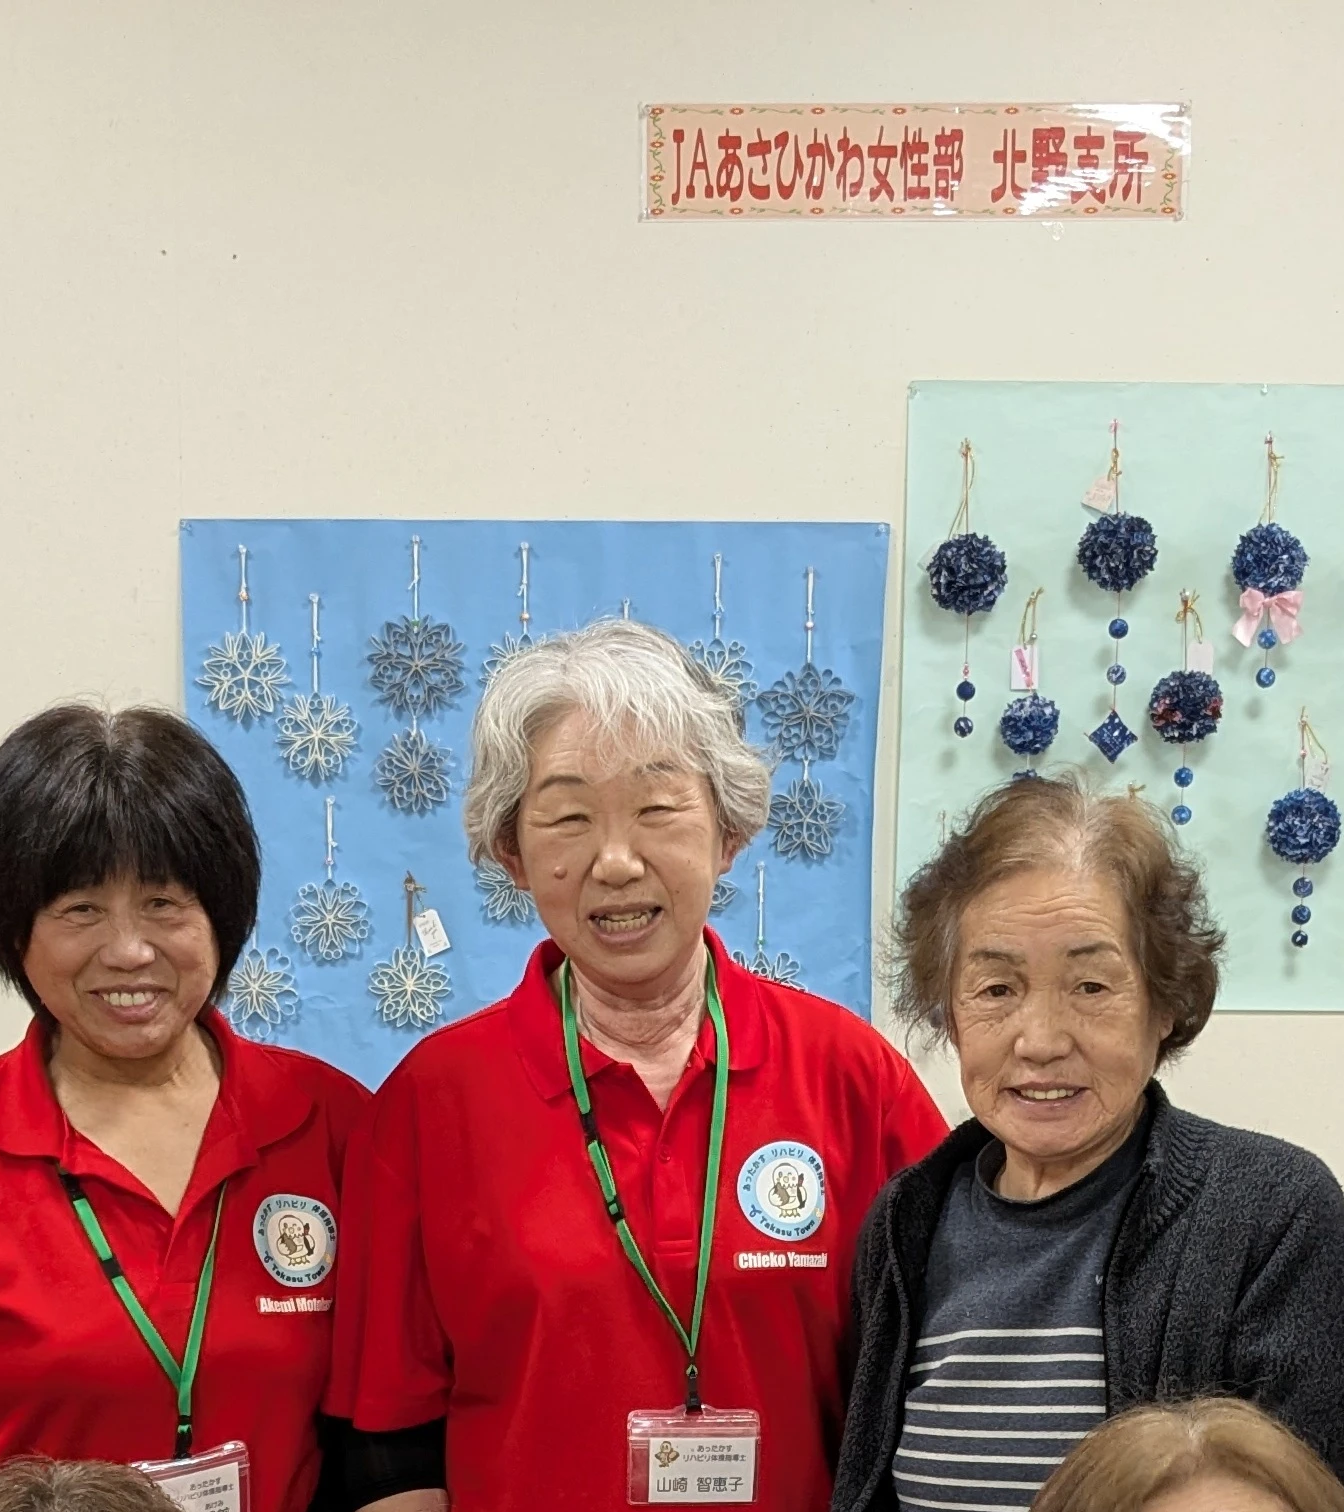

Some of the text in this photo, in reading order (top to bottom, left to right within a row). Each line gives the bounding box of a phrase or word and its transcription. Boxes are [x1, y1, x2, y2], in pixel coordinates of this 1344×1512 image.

[671, 125, 1150, 205] JAあさひかわ女性部 北野支所
[771, 1148, 804, 1158] リハビリ
[759, 1217, 815, 1237] Takasu Town
[739, 1252, 786, 1269] Chieko
[259, 1297, 296, 1313] Akemi
[697, 1445, 733, 1453] あったかす
[656, 1477, 744, 1492] 山崎 智恵子
